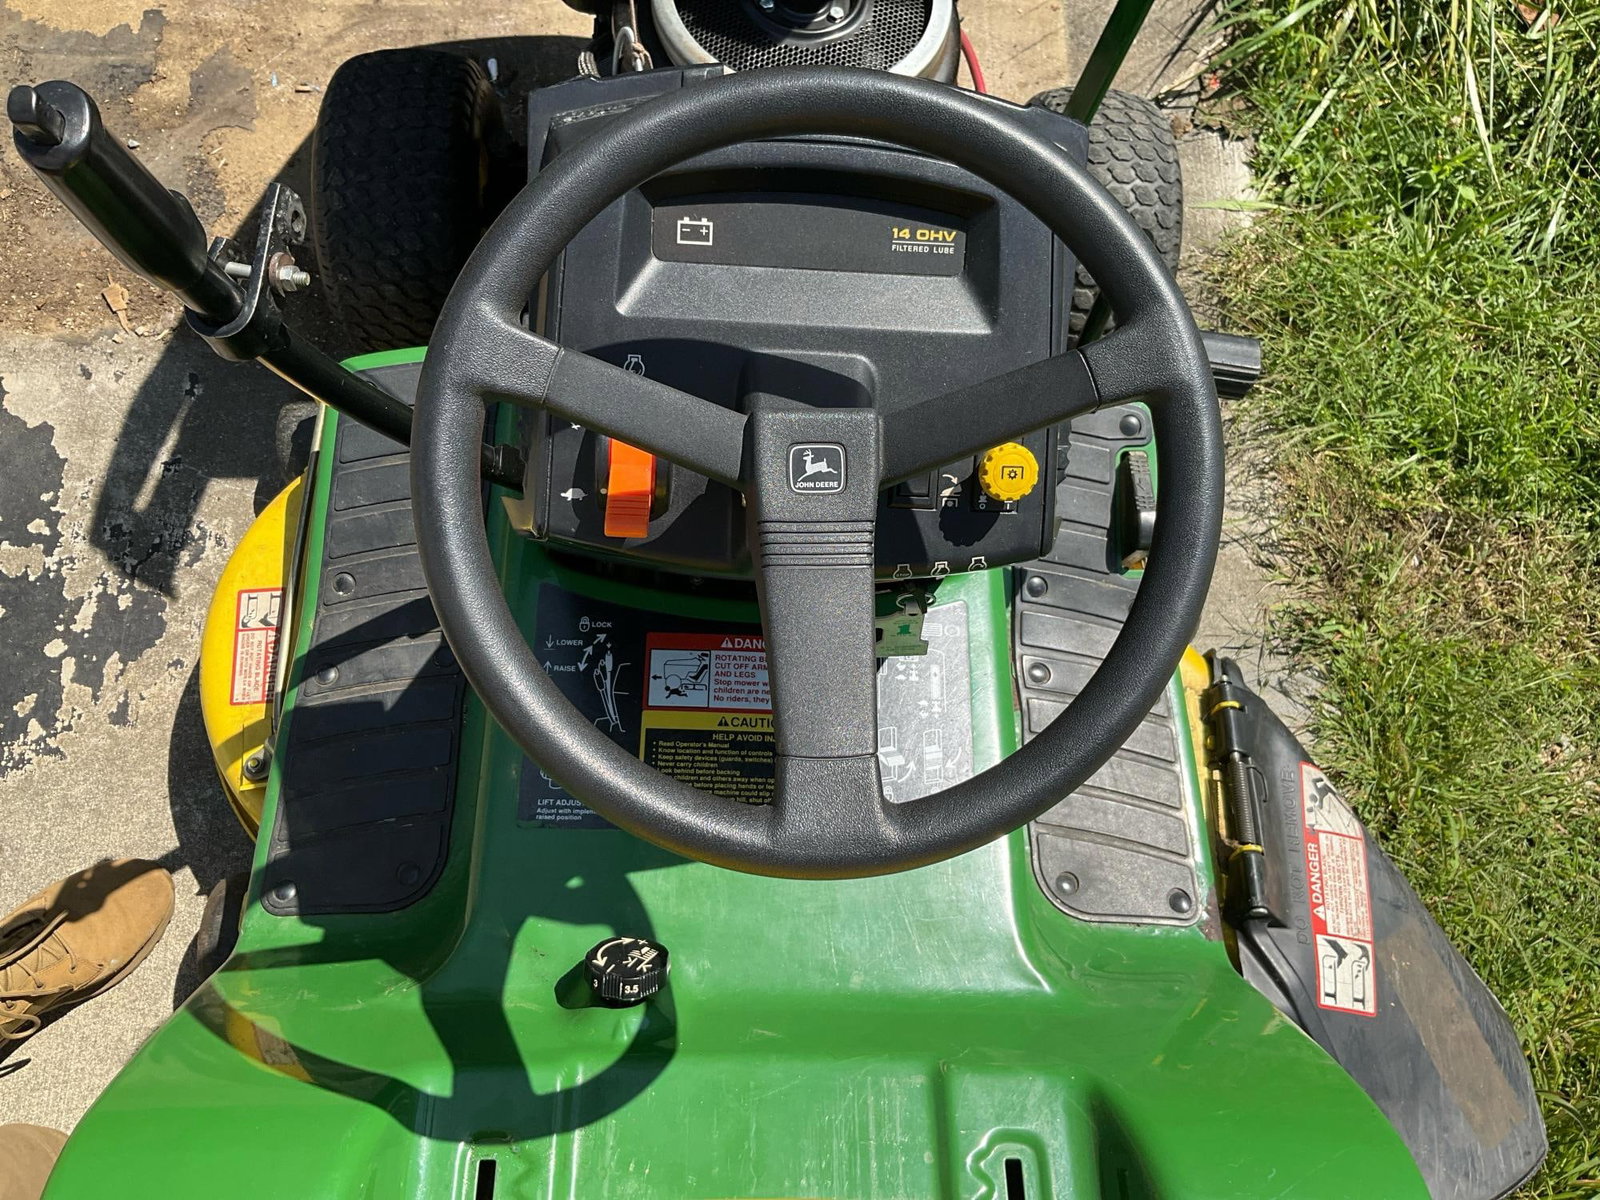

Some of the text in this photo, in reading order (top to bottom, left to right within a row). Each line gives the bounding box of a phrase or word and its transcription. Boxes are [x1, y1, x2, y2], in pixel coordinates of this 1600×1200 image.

[892, 227, 957, 242] 14 OHV
[891, 244, 955, 254] FILTERED LUBE
[715, 654, 757, 662] ROTATING
[753, 696, 770, 704] they
[737, 734, 763, 742] AVOID
[536, 807, 557, 815] Adjust
[1307, 841, 1322, 904] DANGER
[593, 979, 599, 987] 3
[624, 984, 639, 994] 3.5
